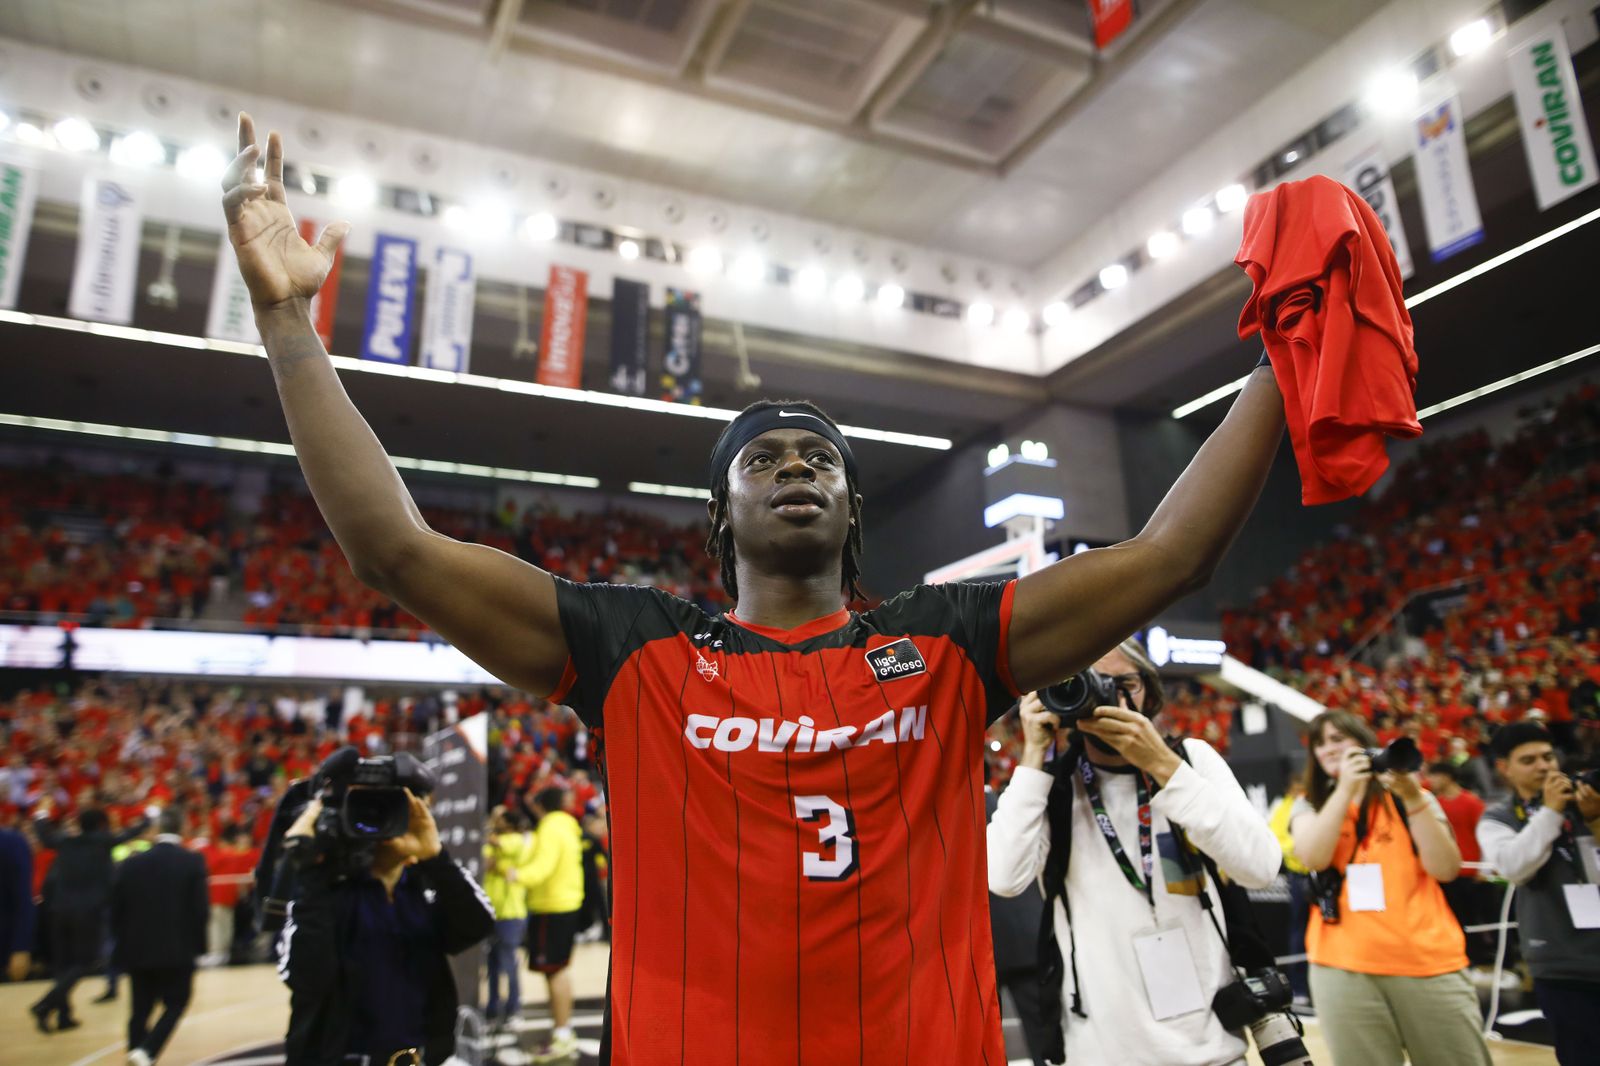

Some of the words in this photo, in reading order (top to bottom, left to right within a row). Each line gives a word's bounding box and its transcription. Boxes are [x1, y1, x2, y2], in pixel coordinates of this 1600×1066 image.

[369, 244, 410, 358] PULEVA
[874, 655, 896, 667] liga
[880, 659, 923, 676] endesa
[793, 794, 860, 882] 3
